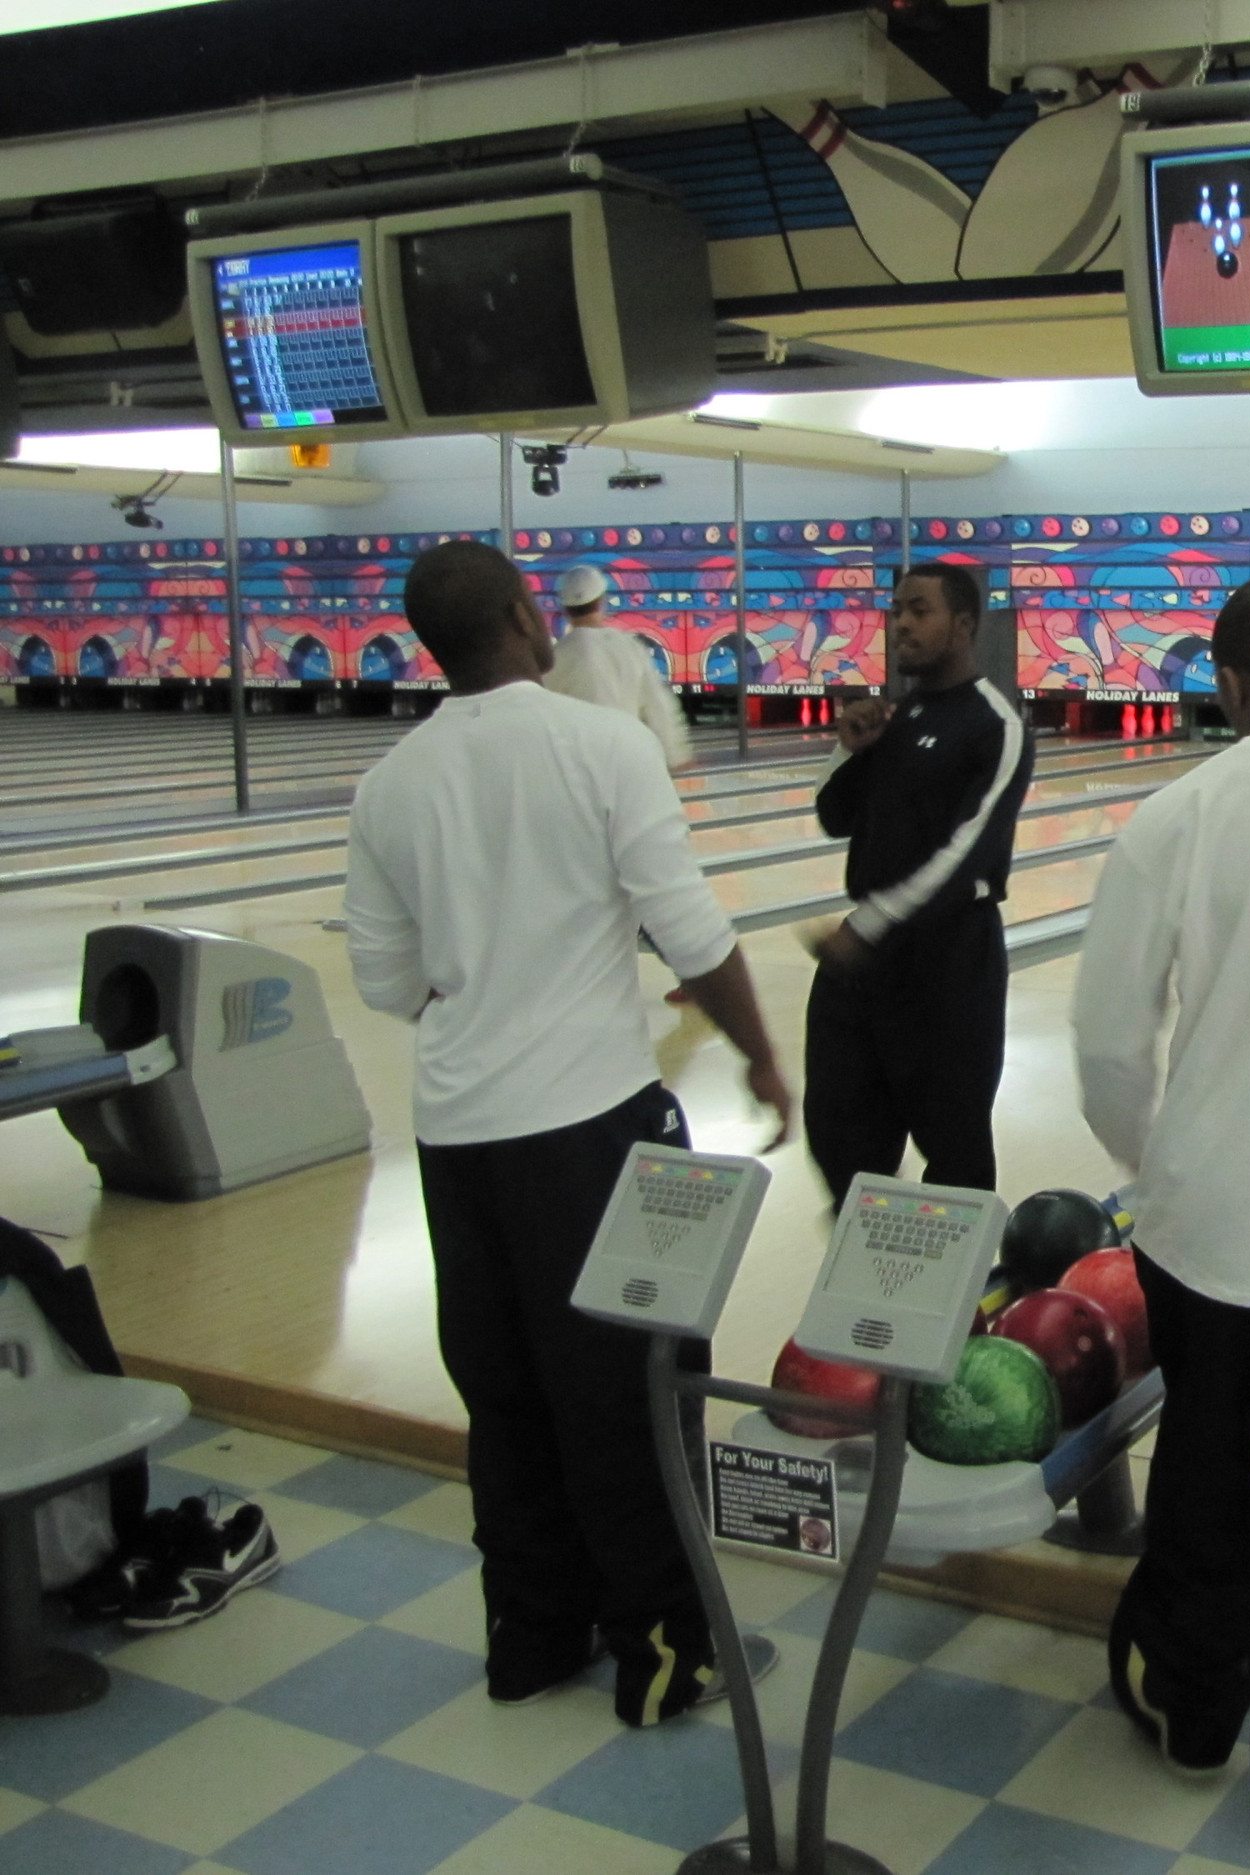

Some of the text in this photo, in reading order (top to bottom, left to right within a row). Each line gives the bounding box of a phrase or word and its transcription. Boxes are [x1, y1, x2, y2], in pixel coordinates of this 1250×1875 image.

[1177, 353, 1209, 365] Copyright
[394, 681, 428, 690] HOLIDAY
[746, 684, 825, 695] HOLIDAY LANES
[869, 686, 881, 696] 12
[1022, 689, 1035, 699] 13
[1086, 691, 1179, 702] HOLIDAY LANES
[715, 1447, 738, 1465] For
[742, 1451, 774, 1471] Your
[779, 1458, 829, 1484] Safety!
